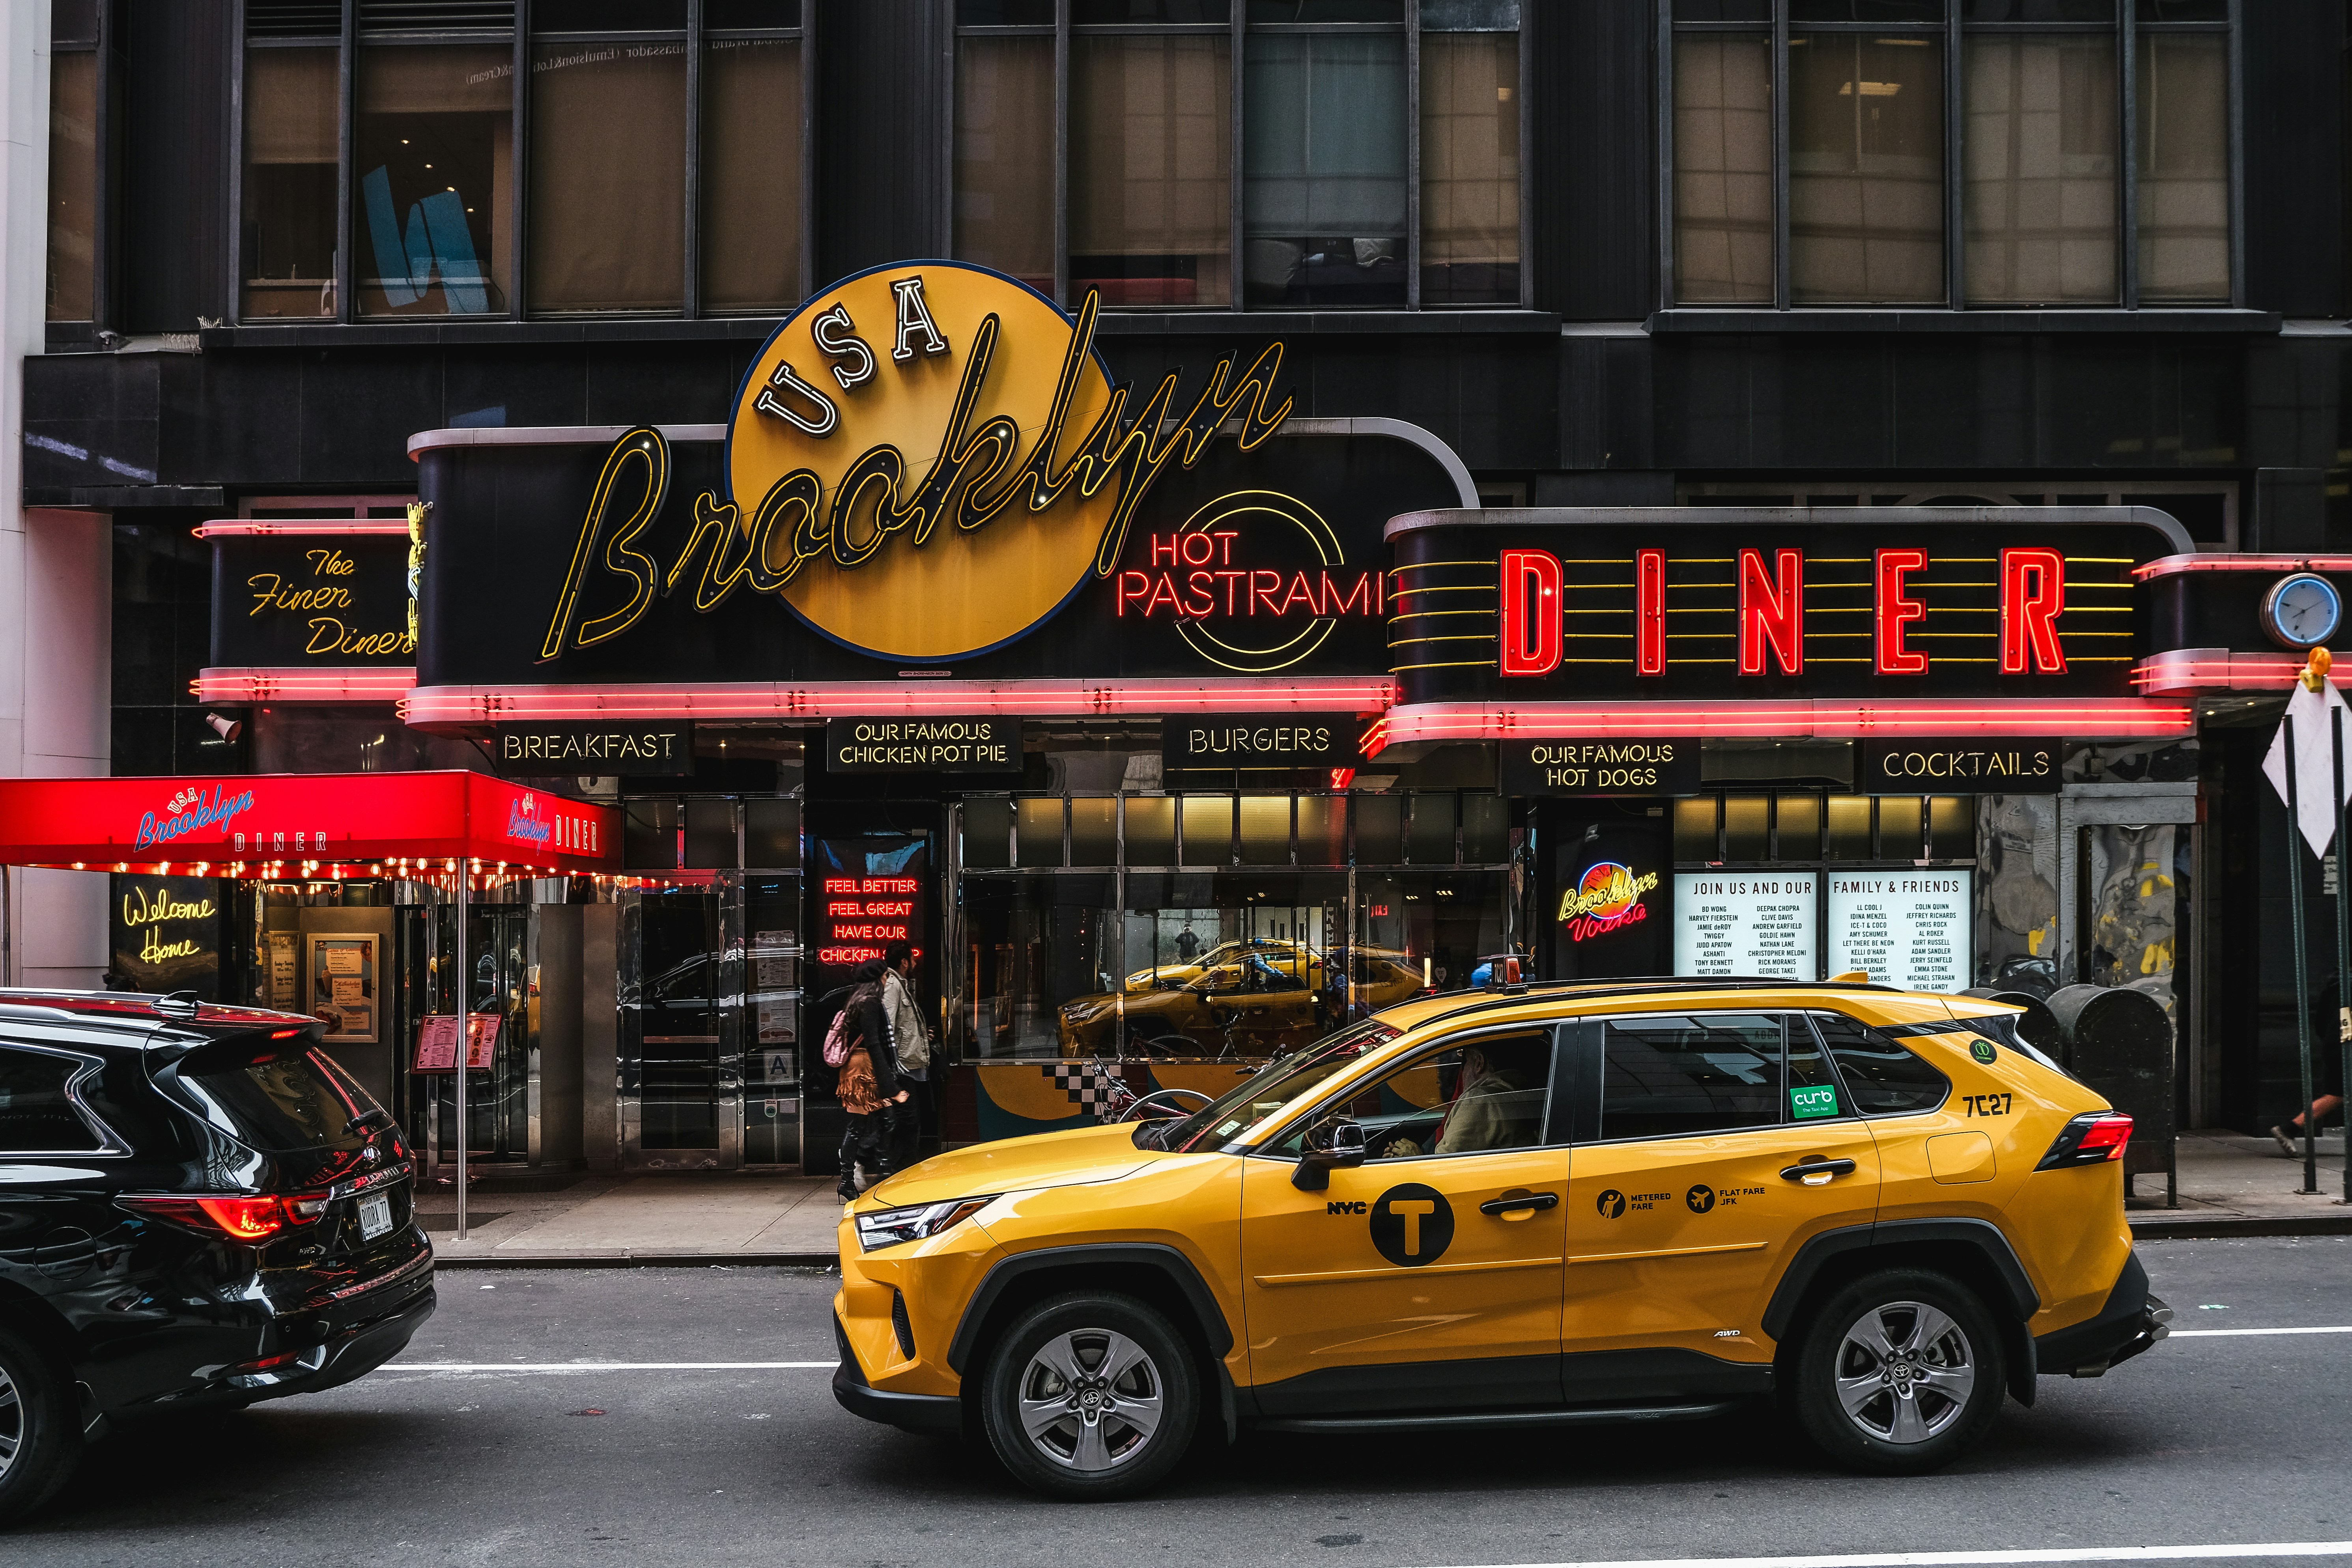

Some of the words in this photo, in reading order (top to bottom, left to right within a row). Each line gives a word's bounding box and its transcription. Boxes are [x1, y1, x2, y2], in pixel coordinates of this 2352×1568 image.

[752, 275, 952, 440] USA
[534, 282, 1297, 666] Brooklyn
[1152, 532, 1238, 566] HOT
[307, 549, 354, 576] The
[248, 574, 354, 617] Finer
[1118, 570, 1384, 617] PASTRAMI
[1501, 547, 2068, 677] DINER
[306, 617, 413, 655] Diner
[856, 724, 899, 741] OUR
[905, 723, 991, 740] FAMOUS
[1190, 728, 1329, 753] BURGERS
[505, 734, 676, 759] BREAKFAST
[840, 746, 926, 763] CHICKEN
[932, 746, 971, 762] POT
[977, 745, 1006, 761] PIE
[1532, 745, 1577, 764] OUR
[1583, 745, 1674, 763] FAMOUS
[1884, 751, 2049, 776] COCKTAILS
[1547, 769, 1589, 786] HOT
[1599, 768, 1657, 787] DOGS
[168, 787, 198, 814] USA
[133, 784, 254, 852] Brooklyn
[507, 798, 551, 856] Brooklyn
[234, 831, 326, 852] DINER
[556, 815, 596, 851] DINER
[825, 880, 860, 893] FEEL
[863, 880, 917, 892] BETTER
[1558, 867, 1658, 921] Brooklyn
[1694, 882, 1722, 895] JOIN
[1730, 882, 1746, 895] US
[1752, 882, 1778, 894] AND
[1786, 882, 1811, 894] OUR
[1834, 881, 1882, 893] FAMILY
[1889, 881, 1896, 893] &
[1903, 880, 1959, 893] FRIENDS
[124, 886, 216, 926] Welcome
[829, 903, 865, 916] FEEL
[866, 903, 912, 915] GREAT
[835, 925, 872, 938] HAVE
[875, 926, 906, 938] OUR
[1567, 904, 1646, 941] Vodka
[140, 925, 200, 964] Home
[820, 949, 878, 962] CHICKEN
[770, 1055, 787, 1075] A
[1794, 1090, 1833, 1105] curb
[1962, 1093, 2012, 1118] 7C27
[1327, 1201, 1367, 1215] NYC
[1631, 1192, 1671, 1202] METERED
[1631, 1202, 1653, 1211] FARE
[361, 1204, 380, 1230] RUDRA
[379, 1200, 388, 1222] 77
[365, 1226, 393, 1241] MASSAPEQUA
[1389, 1200, 1434, 1256] T
